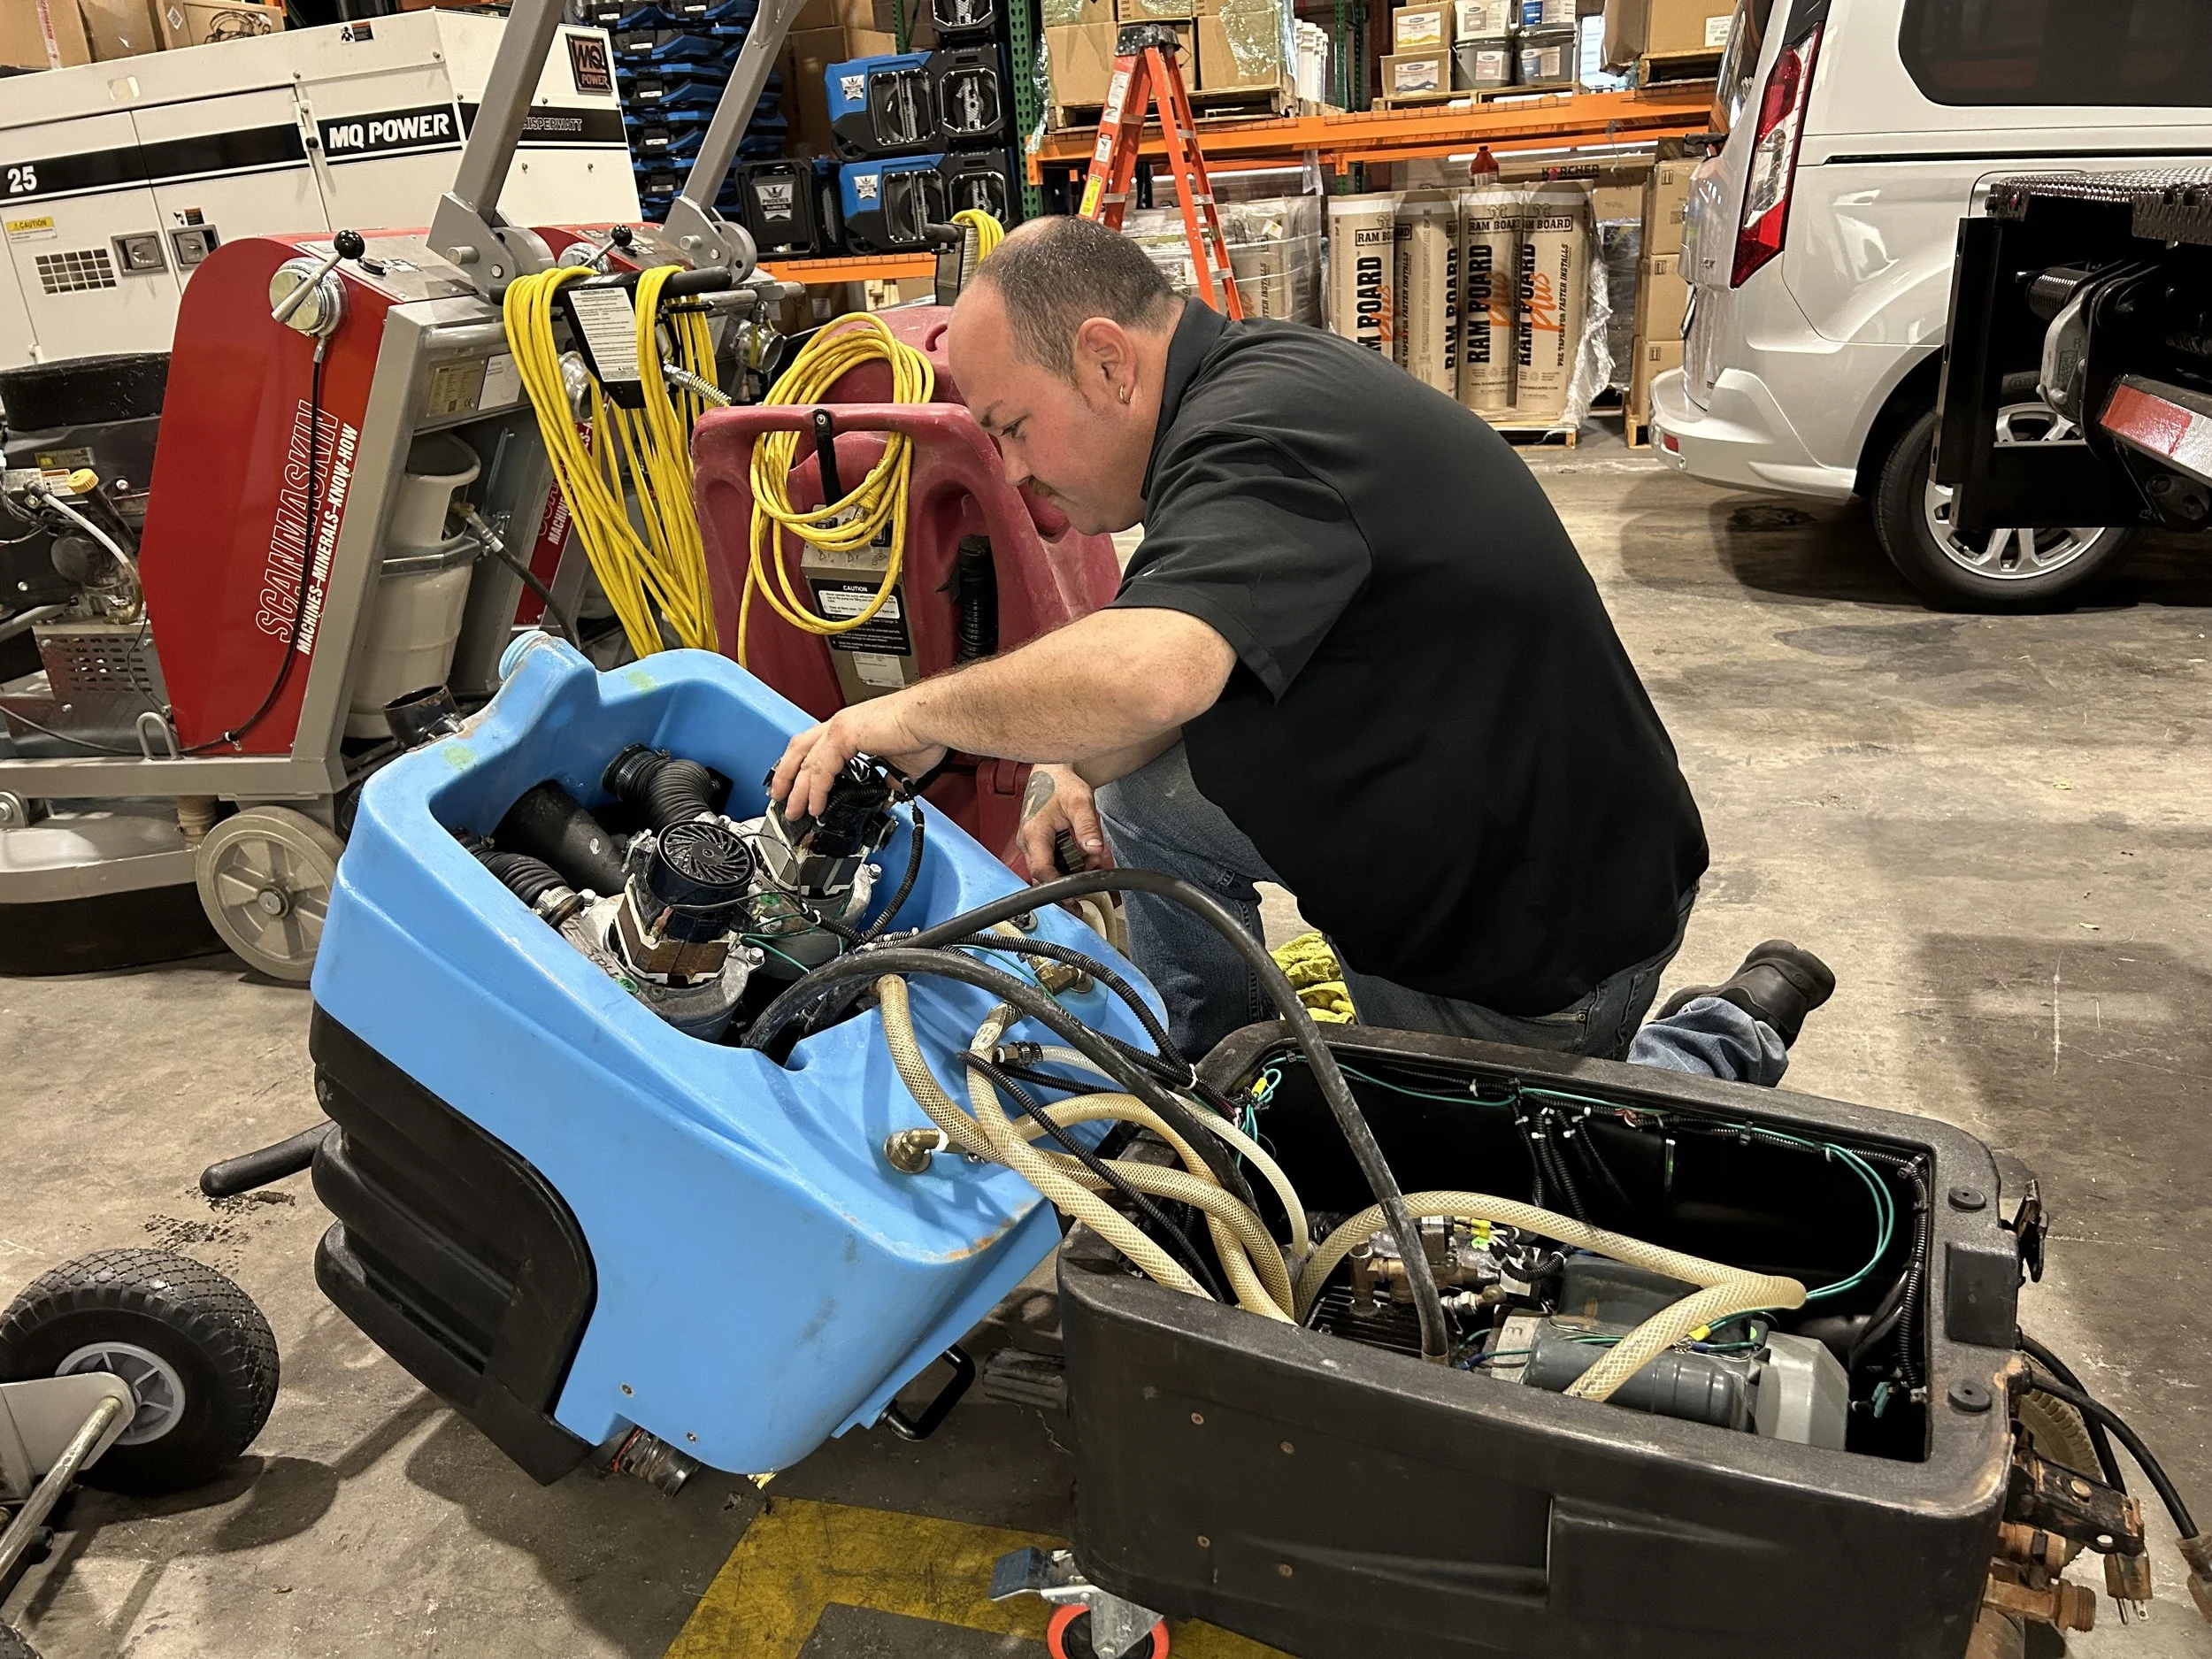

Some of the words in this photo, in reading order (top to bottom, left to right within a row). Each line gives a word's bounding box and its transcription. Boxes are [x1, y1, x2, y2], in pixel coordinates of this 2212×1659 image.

[577, 44, 611, 71] MQ
[581, 73, 608, 86] POWER
[329, 123, 365, 150] MQ
[368, 112, 450, 144] POWER
[7, 165, 38, 194] 25
[19, 219, 47, 229] CAUTION
[1357, 231, 1379, 243] RAM
[1470, 221, 1490, 231] RAM
[1537, 219, 1571, 229] BOARD
[1468, 244, 1493, 313] BOARD
[1560, 243, 1569, 281] INSTALLS
[1357, 257, 1381, 329] BOARD
[1523, 273, 1563, 332] plus
[1558, 282, 1567, 311] FASTER
[1445, 326, 1457, 370] RAM
[1467, 320, 1490, 364] RAM
[256, 399, 340, 644] SCANMASKIN
[548, 495, 569, 546] MACHINE
